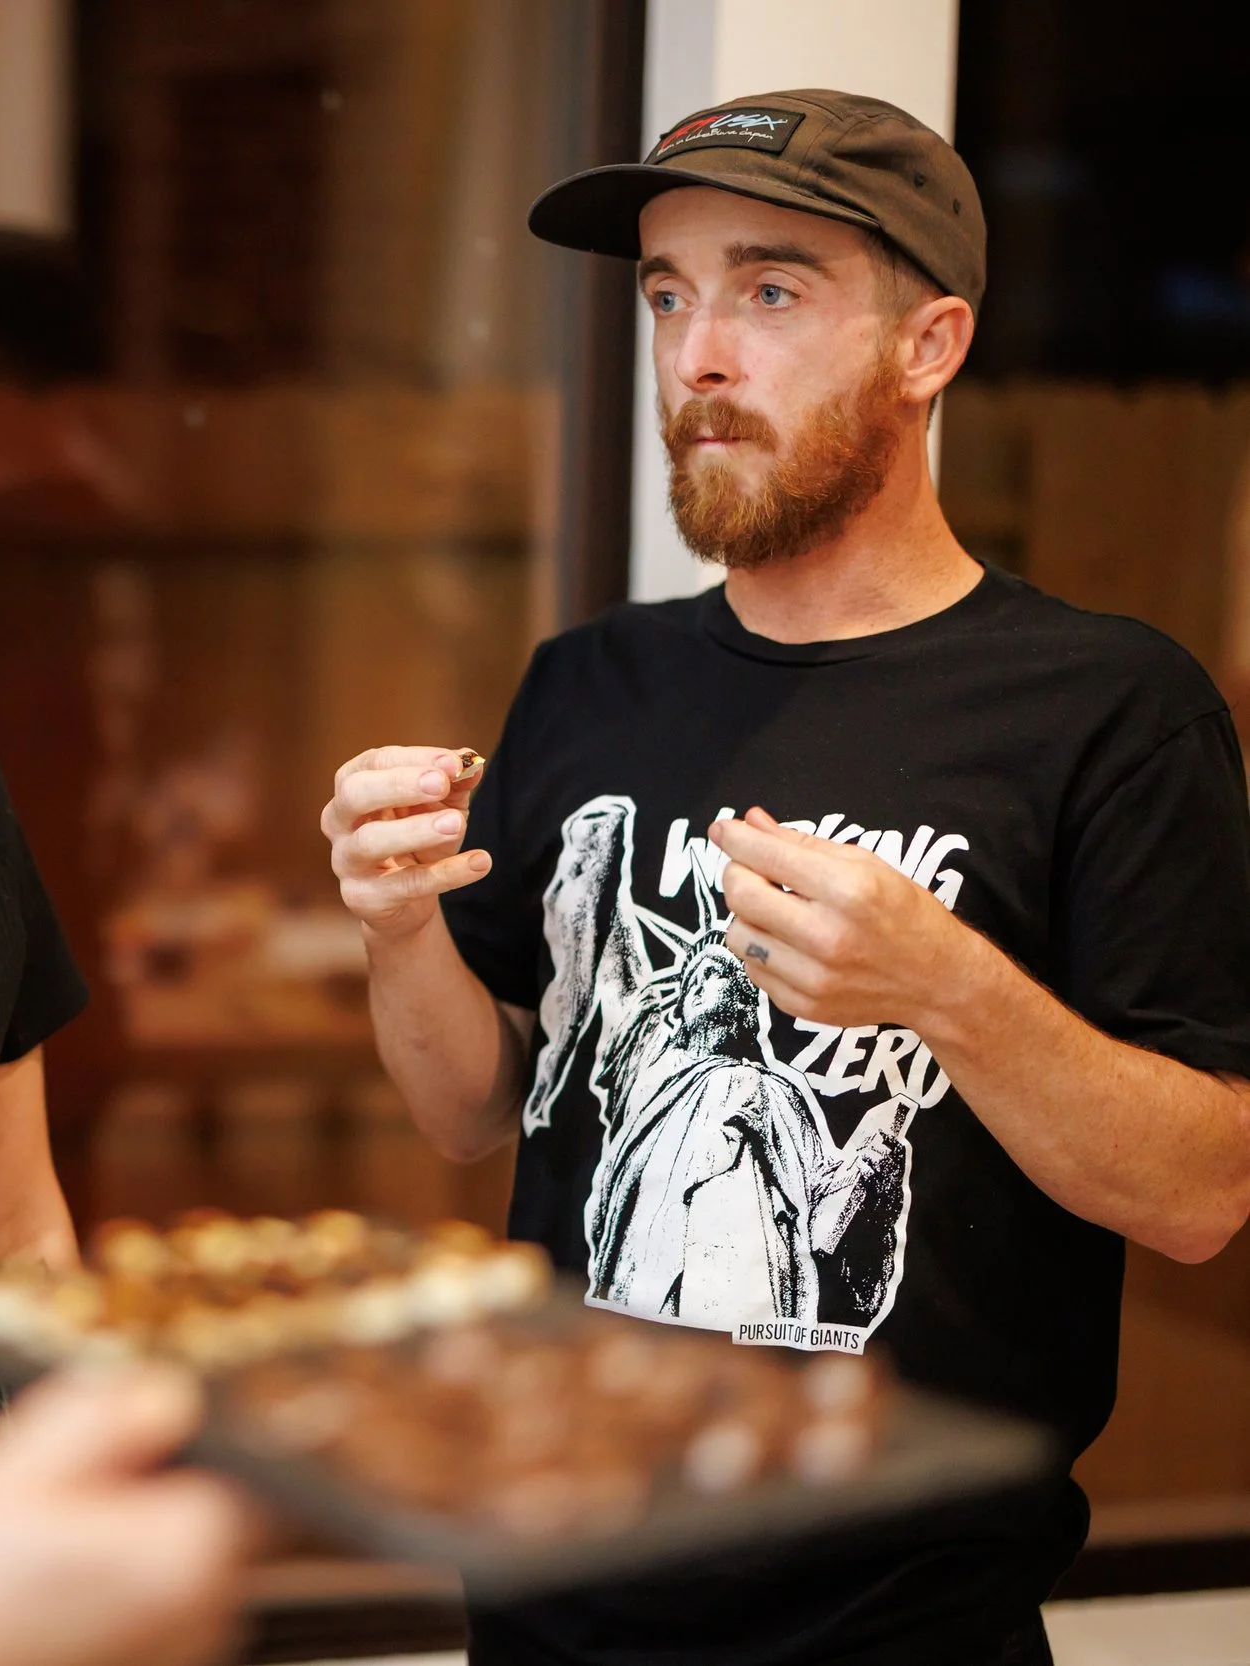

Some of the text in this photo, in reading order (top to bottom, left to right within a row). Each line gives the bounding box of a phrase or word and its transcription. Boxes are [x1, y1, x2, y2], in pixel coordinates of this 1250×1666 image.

[739, 1323, 860, 1350] PURSUIT OF GIANTS
